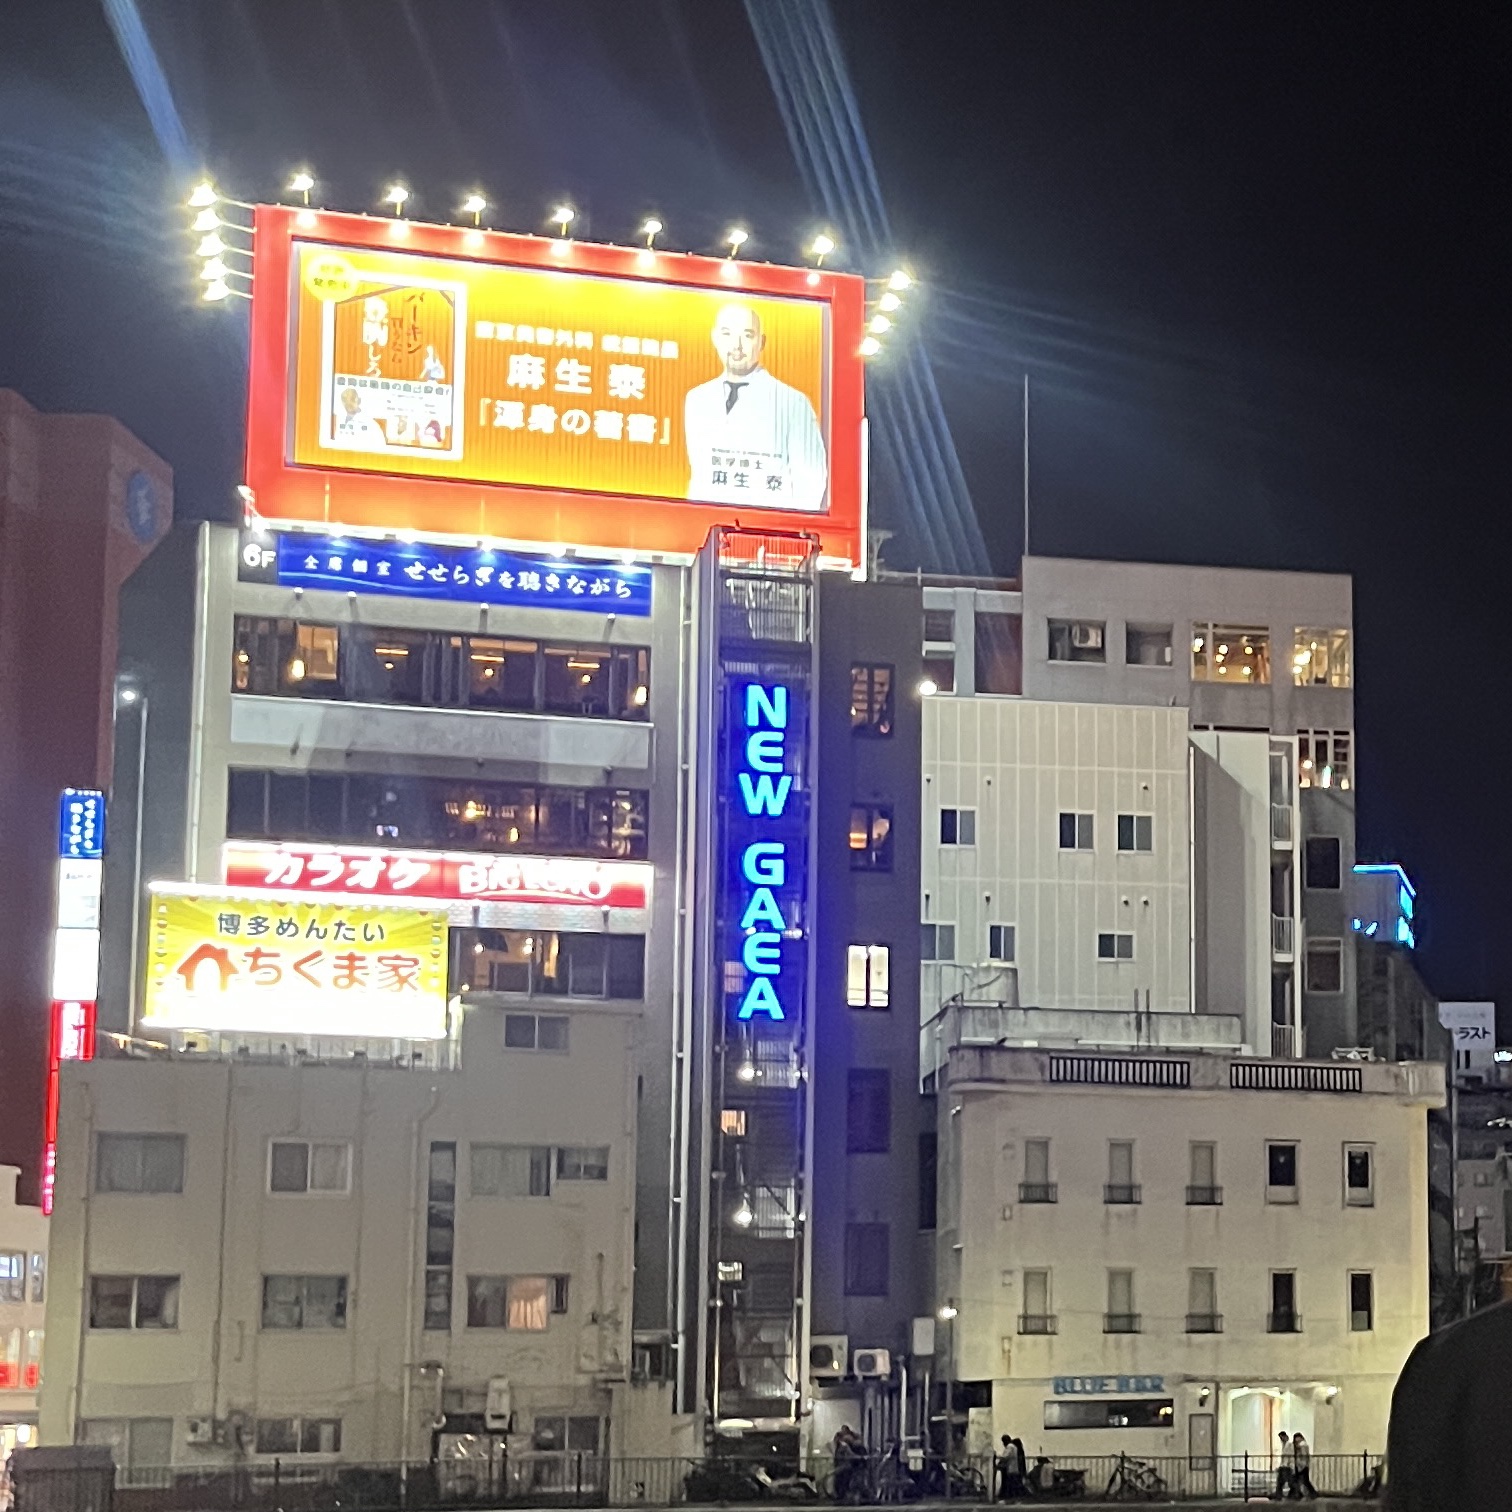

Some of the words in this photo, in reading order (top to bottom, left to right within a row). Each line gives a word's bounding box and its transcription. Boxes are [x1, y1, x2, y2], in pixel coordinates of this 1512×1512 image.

[243, 543, 276, 568] 6F
[404, 560, 632, 599] せせらぎを聴きながら
[738, 684, 792, 816] NEW
[264, 852, 430, 889] カラオケ
[217, 912, 386, 942] 博多めんたい
[738, 842, 786, 1020] GAEA
[243, 946, 420, 992] ちくま家
[1455, 1026, 1492, 1040] ラスト
